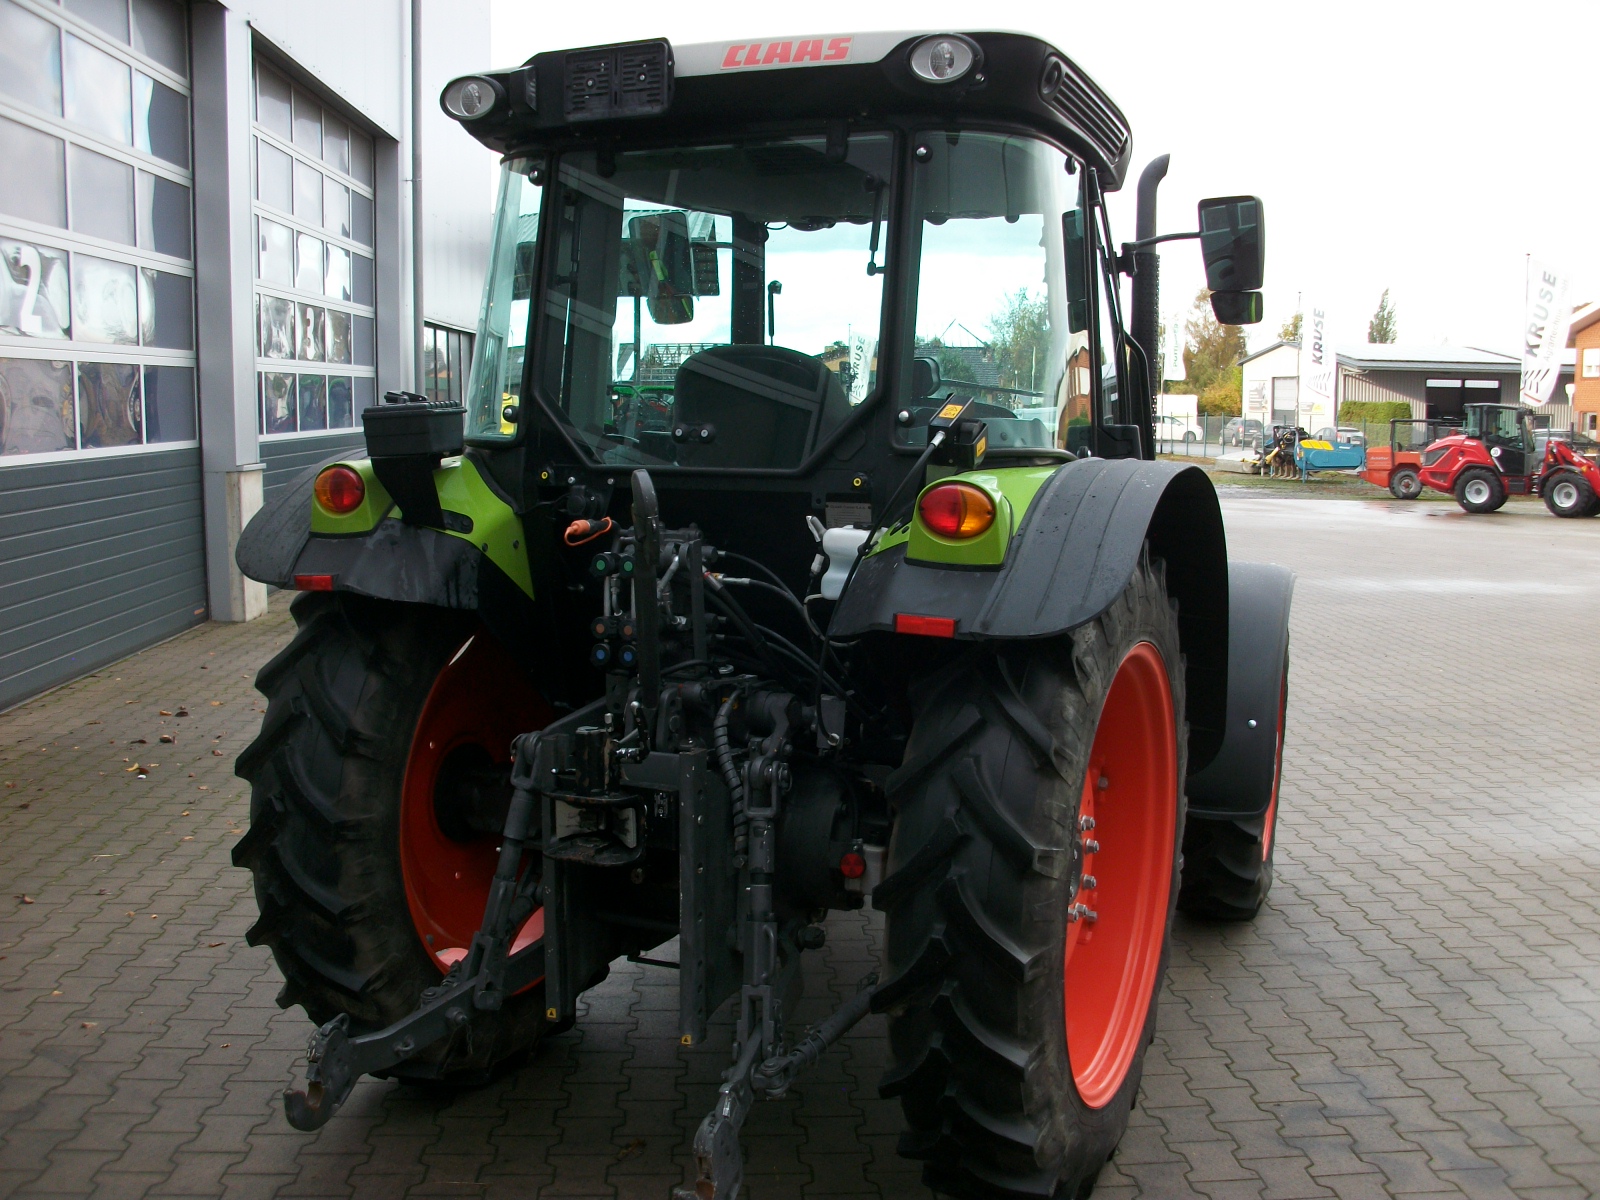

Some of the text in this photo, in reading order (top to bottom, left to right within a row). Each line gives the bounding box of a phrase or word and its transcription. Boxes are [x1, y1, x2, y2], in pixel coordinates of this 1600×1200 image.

[721, 36, 852, 68] CLAAS
[20, 246, 42, 333] 2
[1525, 270, 1558, 358] KRUSE
[306, 307, 316, 360] 3
[1312, 307, 1325, 366] KRUSE
